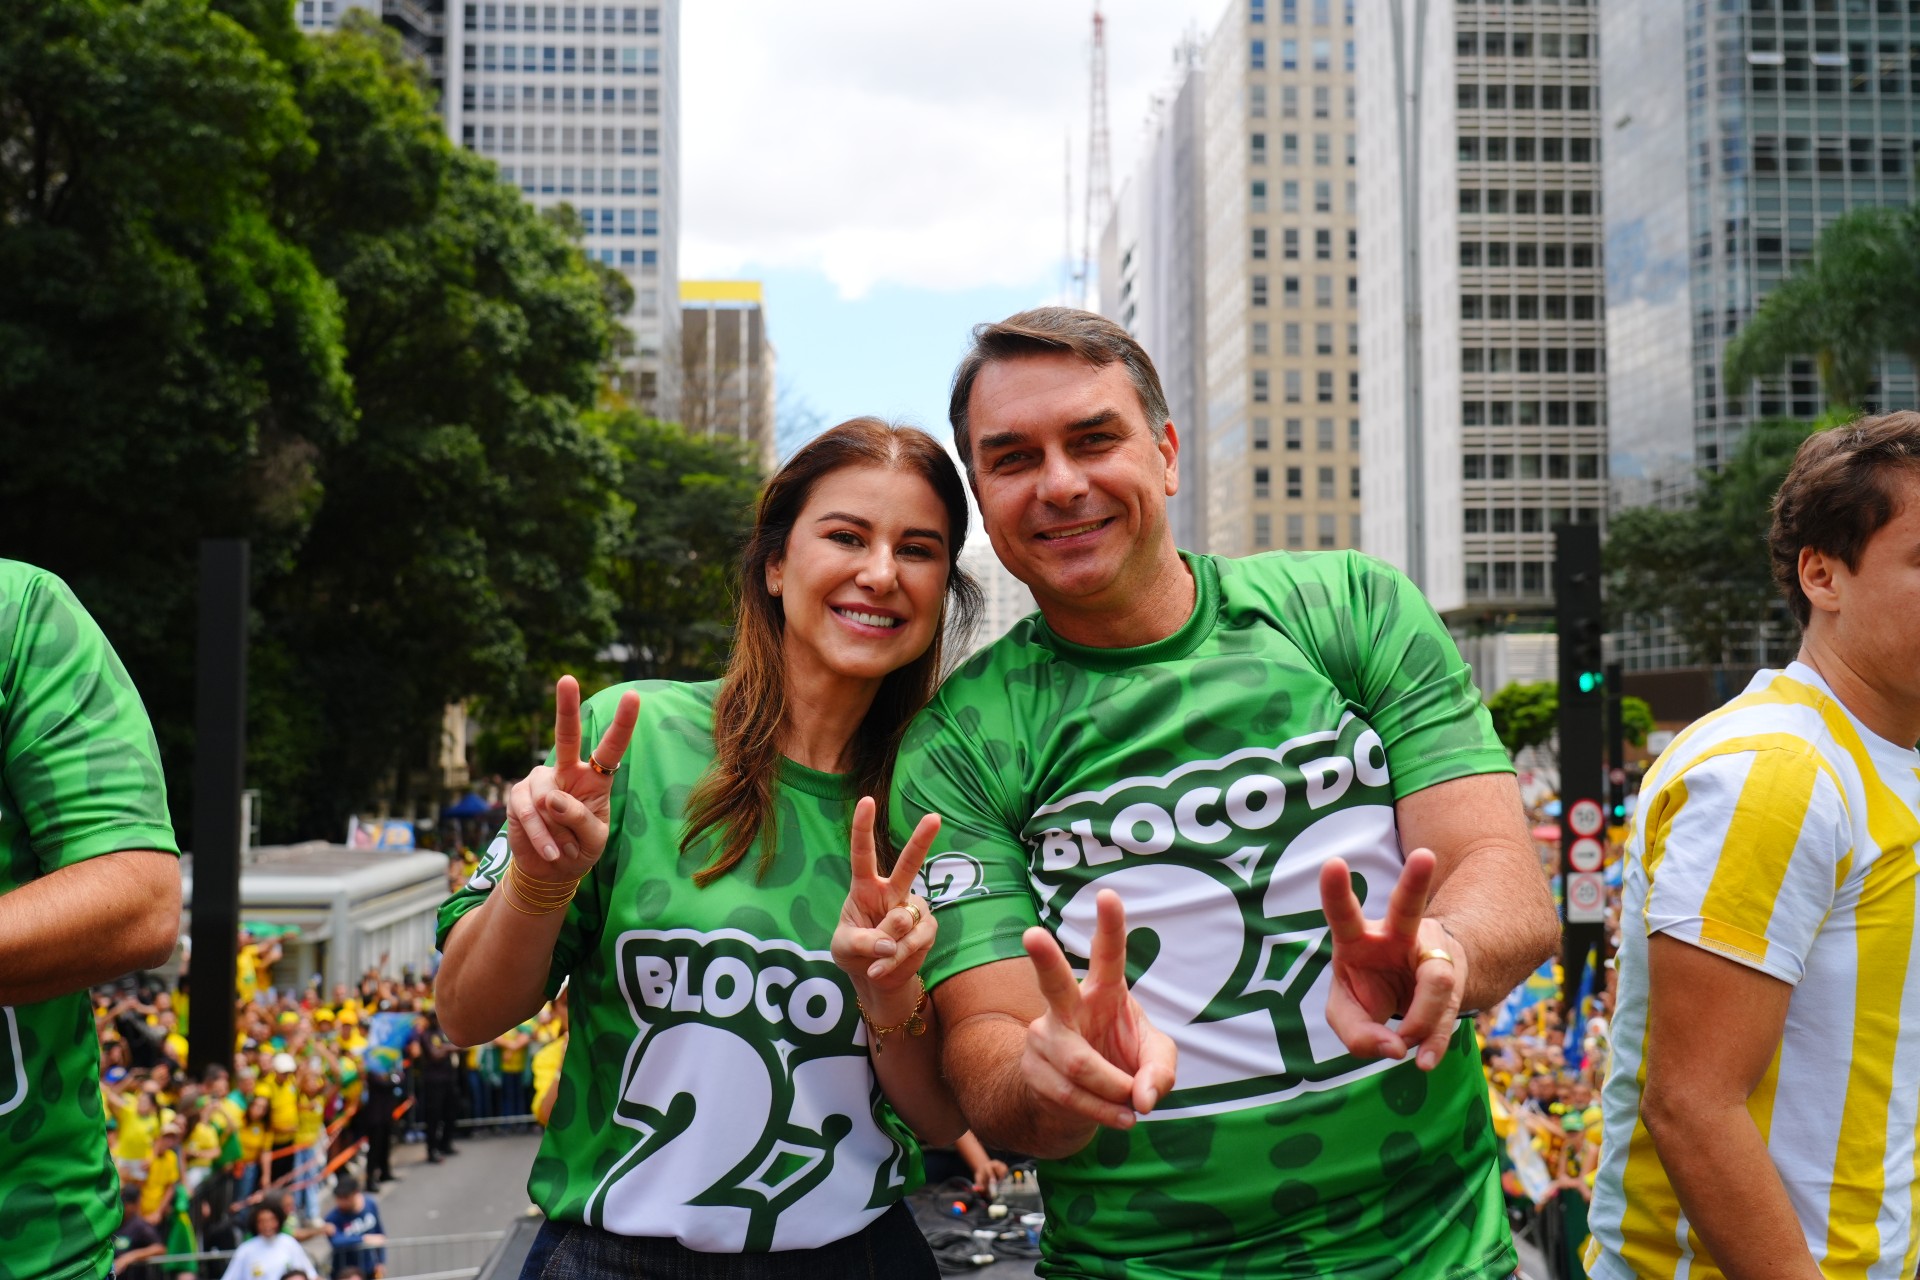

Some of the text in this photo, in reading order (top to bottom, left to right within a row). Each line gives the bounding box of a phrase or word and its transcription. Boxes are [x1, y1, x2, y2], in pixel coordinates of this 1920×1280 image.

[1042, 728, 1390, 872] BLOCO DO
[635, 955, 844, 1035] BLOCO
[602, 1022, 897, 1253] 22
